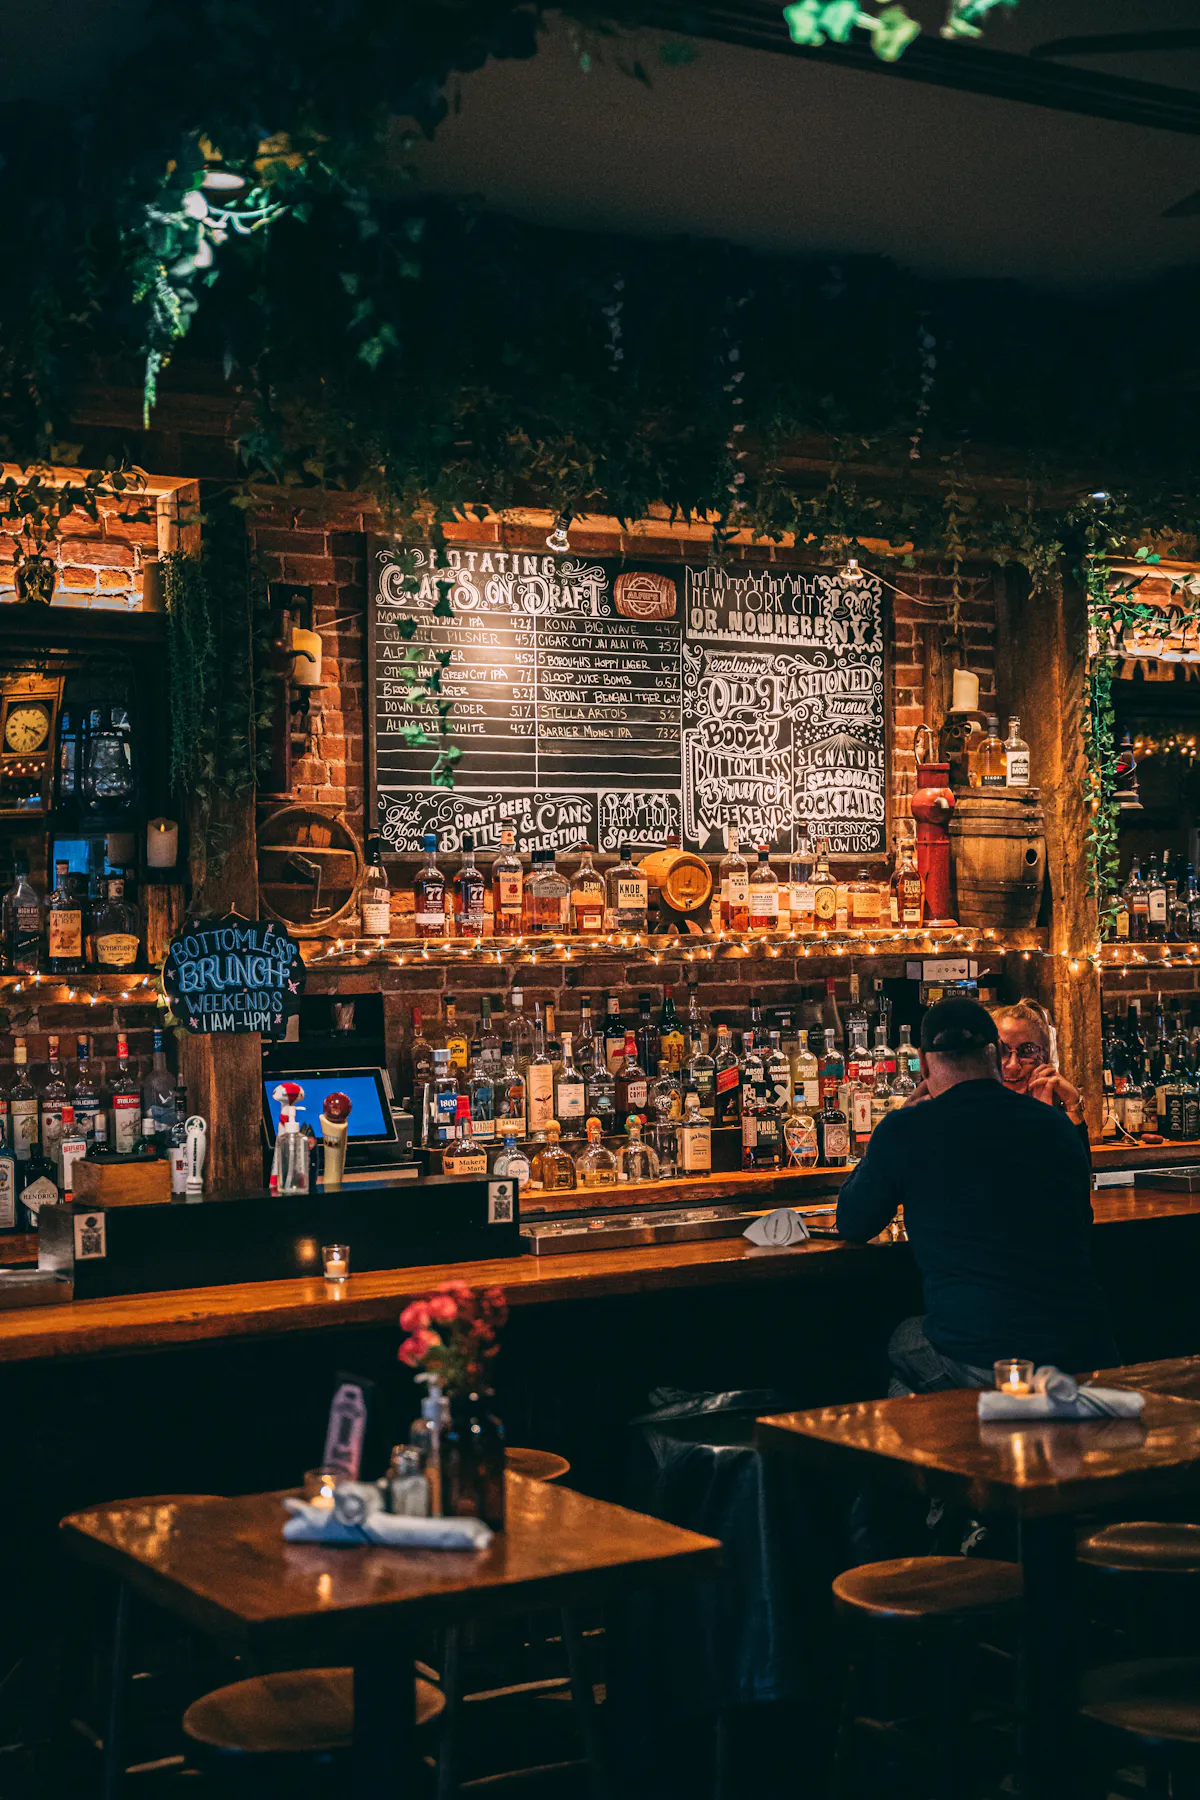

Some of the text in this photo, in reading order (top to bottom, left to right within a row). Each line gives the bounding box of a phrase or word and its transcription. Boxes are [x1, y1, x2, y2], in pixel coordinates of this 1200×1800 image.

[485, 574, 517, 605] ON
[519, 573, 609, 616] DRAFT
[692, 587, 826, 615] NEW YORK CITY
[469, 616, 485, 628] IPA
[544, 618, 577, 632] KONA
[584, 621, 604, 634] BIG
[606, 624, 640, 635] WAVE
[691, 608, 826, 637] OR NOWHERE
[447, 630, 501, 645] PILSNER
[831, 620, 870, 645] NY
[538, 634, 570, 648] CIGAR
[571, 637, 593, 649] CITY
[595, 639, 608, 649] JAI
[610, 640, 629, 650] ALAI
[632, 640, 649, 651] IPA
[538, 652, 546, 665] 5
[546, 656, 591, 669] BOROUGHS
[594, 657, 619, 669] HOPPY
[621, 659, 650, 670] LAGER
[710, 655, 769, 674] exclusive
[441, 667, 469, 680] GREEN
[490, 668, 508, 681] IPA
[517, 669, 532, 683] 7%
[541, 670, 678, 689] SLOOP JUICE BOMB 6.5%
[512, 688, 535, 701] 5.2%
[543, 687, 588, 703] SIXPOINT
[593, 691, 633, 704] BENGALI
[635, 693, 660, 704] TIGER
[757, 668, 874, 714] FASHIONED
[385, 700, 414, 713] DOWN
[420, 703, 440, 715] EAS
[454, 703, 487, 716] CIDER
[540, 705, 675, 720] STELLA ARTOIS 5%
[832, 700, 868, 715] menu
[538, 724, 582, 738] BARRIER
[583, 725, 614, 738] MONEY
[617, 727, 633, 739] IPA
[701, 718, 778, 755] BOOZY
[696, 747, 792, 785] BOTTOMLESS
[798, 749, 885, 768] SIGNATURE
[806, 769, 880, 792] SEASONAL
[386, 802, 427, 822] Ask
[454, 797, 532, 829] CRAFT BEER
[794, 790, 886, 821] COCKTAILS
[520, 812, 537, 833] &
[536, 803, 592, 833] CANS
[602, 806, 680, 827] HAPPY HOUR
[700, 804, 794, 831] WEEKENDS
[382, 821, 427, 839] About
[807, 823, 872, 835] @ALFIESNYC
[518, 825, 588, 853] SELECTION
[853, 837, 872, 851] US!
[426, 886, 444, 900] 77
[619, 883, 640, 894] KNOB
[170, 928, 298, 965] BOTTOMLESS
[178, 953, 291, 993] BRUNCH
[184, 991, 283, 1014] WEEKENDS
[440, 1099, 457, 1107] 1800
